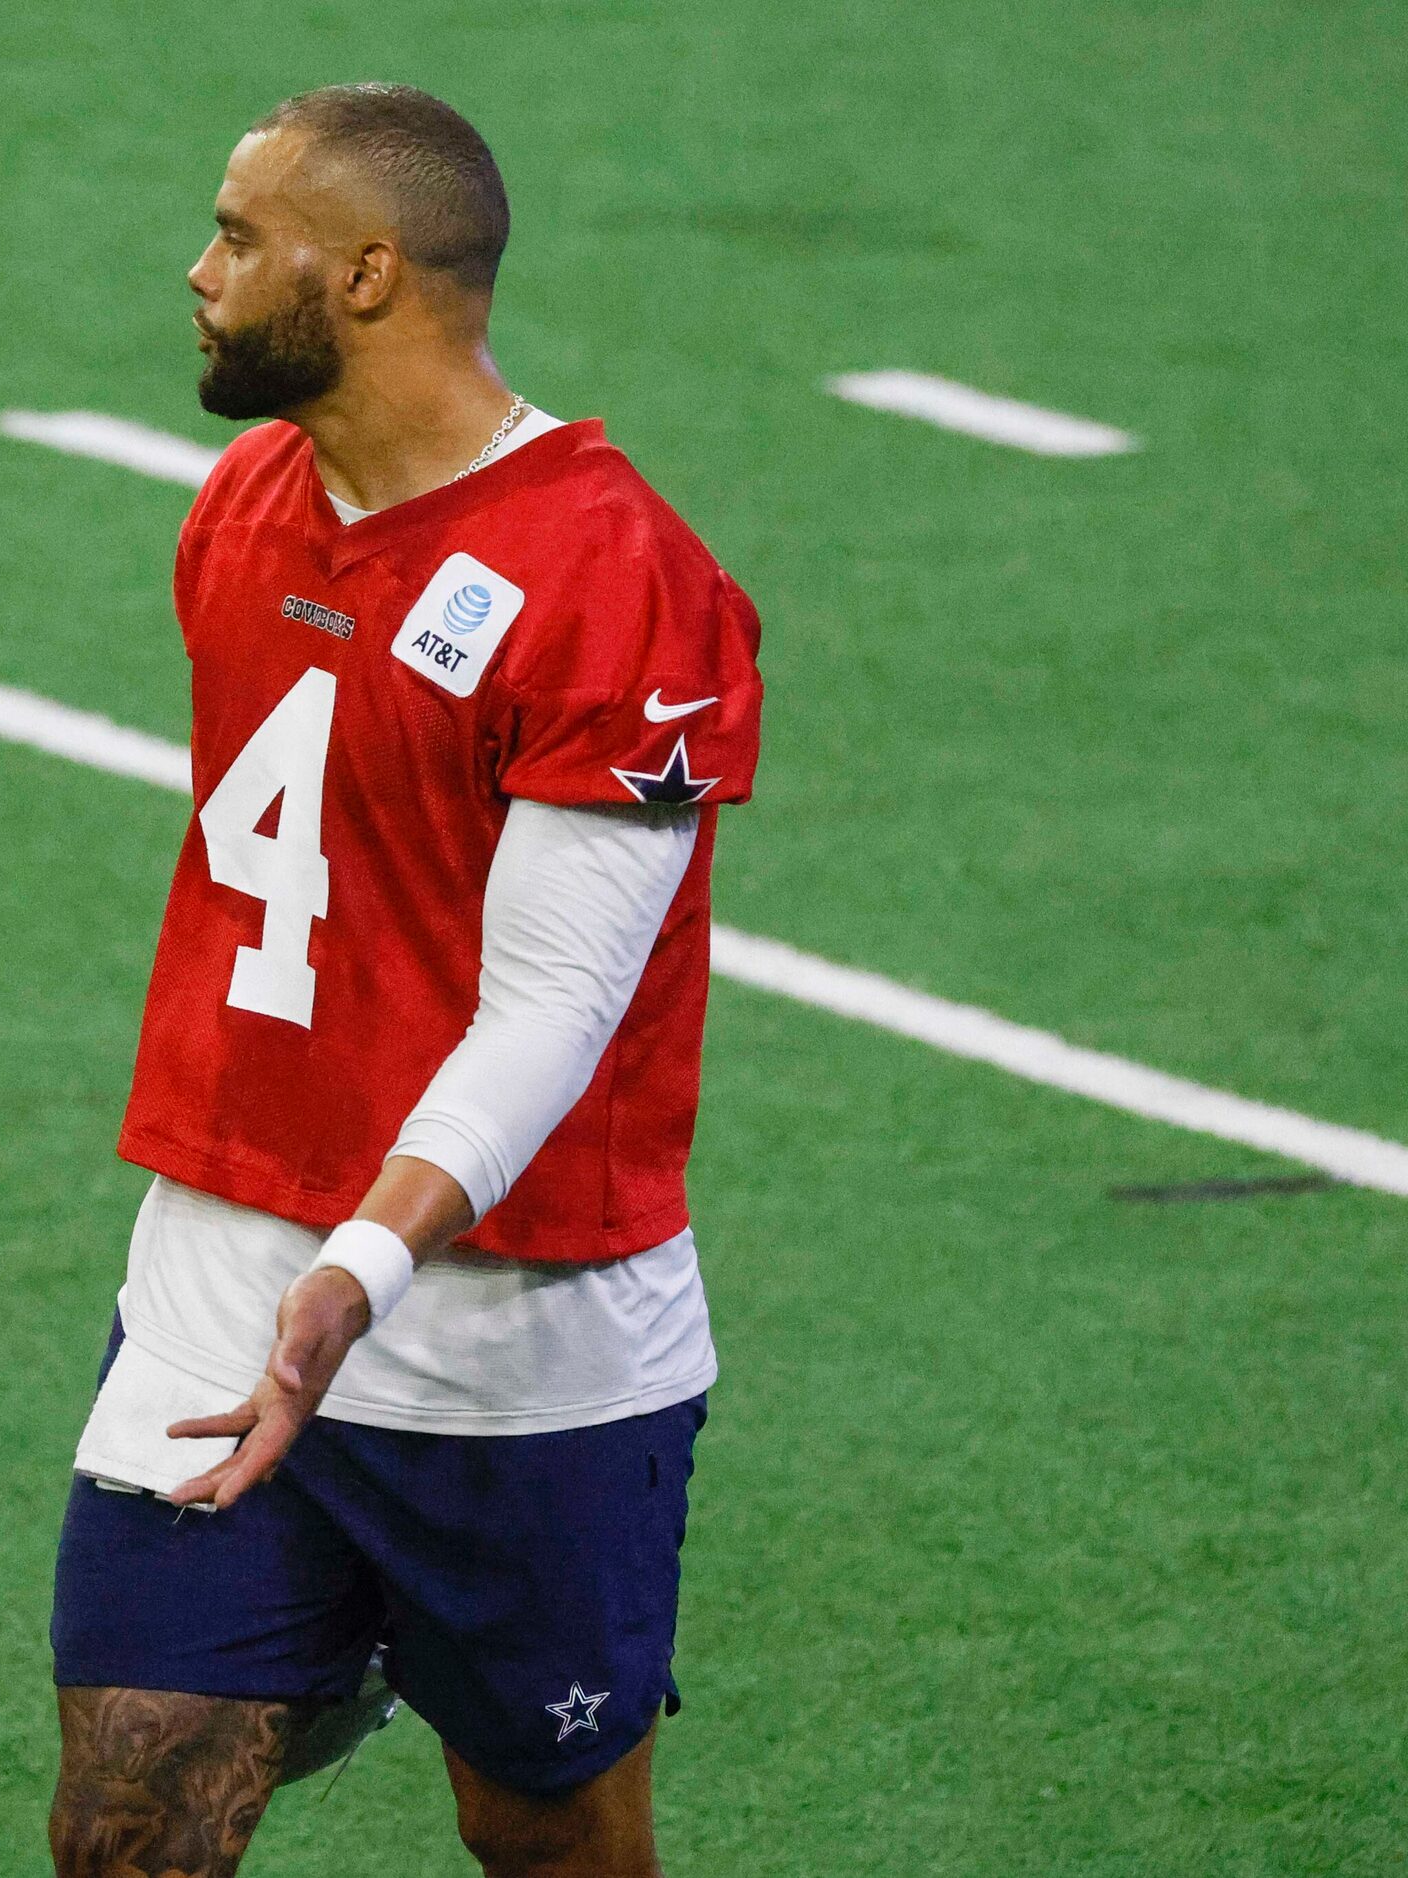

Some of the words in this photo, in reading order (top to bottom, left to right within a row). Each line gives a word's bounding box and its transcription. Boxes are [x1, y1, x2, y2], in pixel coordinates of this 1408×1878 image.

[281, 594, 355, 640] COWBOYS
[411, 629, 469, 673] AT&T
[198, 666, 337, 1031] 4
